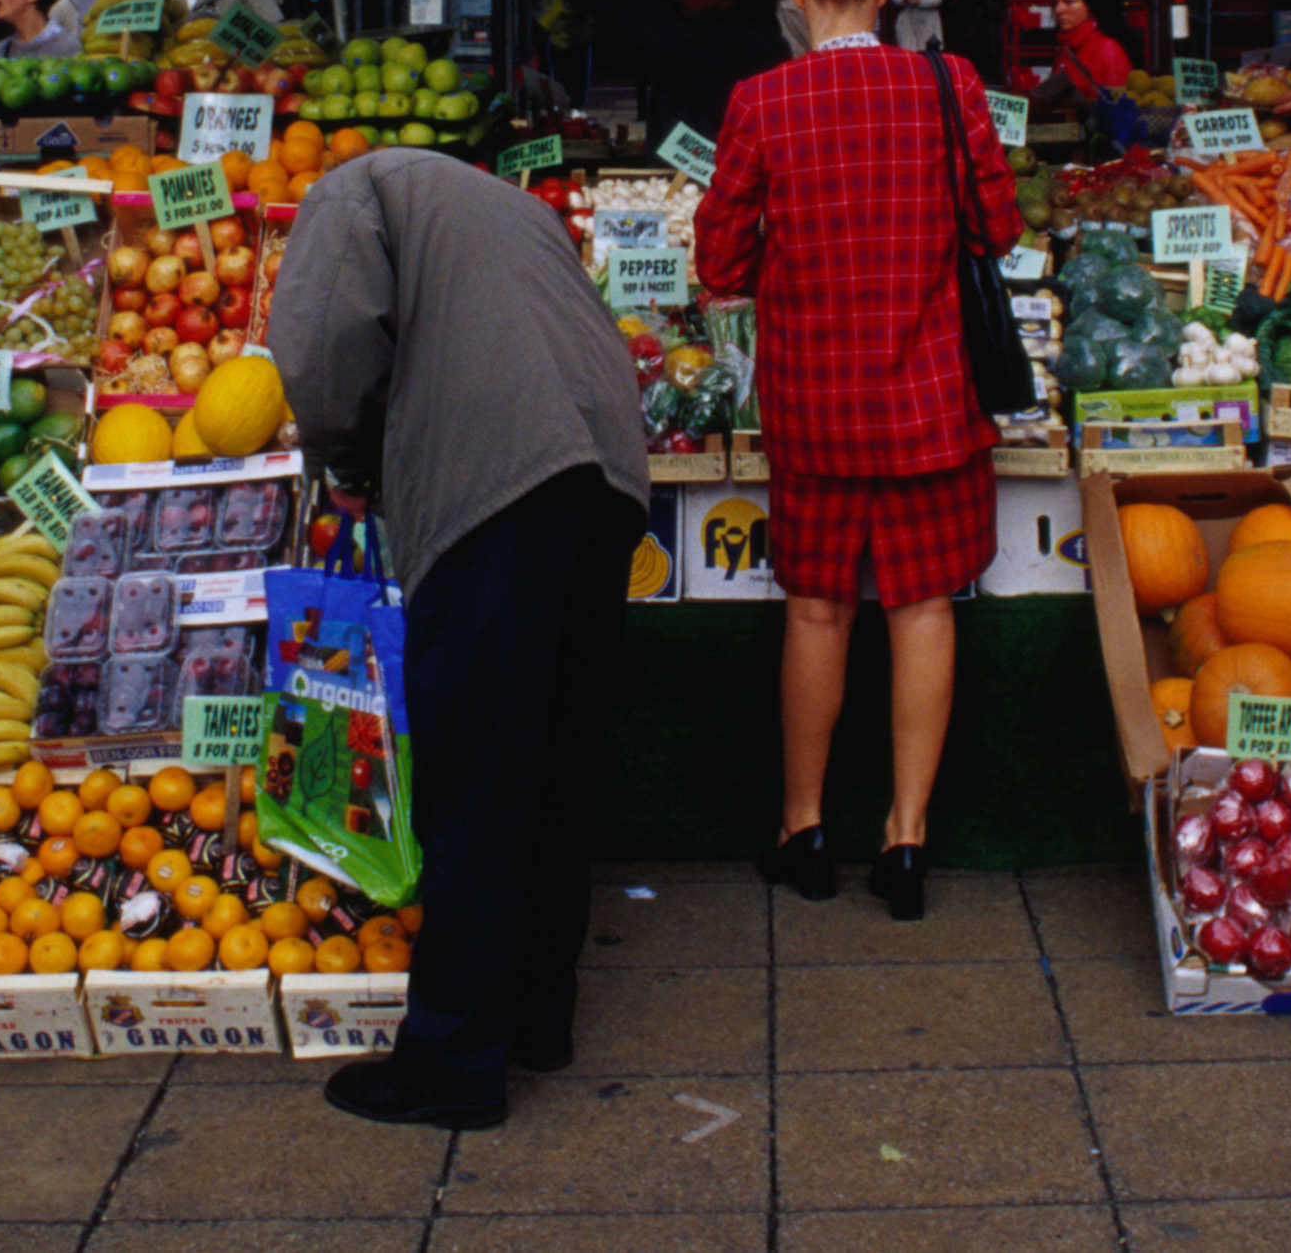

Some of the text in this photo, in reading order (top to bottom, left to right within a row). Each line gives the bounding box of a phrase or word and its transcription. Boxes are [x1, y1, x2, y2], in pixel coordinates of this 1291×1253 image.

[986, 96, 1026, 114] ERENCE
[194, 106, 261, 131] ORANGES
[1194, 115, 1250, 134] CARROTS
[191, 140, 201, 154] 5
[160, 168, 216, 206] POMMIES
[174, 206, 194, 220] FOR
[1166, 213, 1217, 240] SPROUTS
[1173, 242, 1198, 254] BAGS
[619, 258, 678, 277] PEPPERS
[33, 467, 89, 523] BANANA
[290, 669, 388, 716] Organic
[203, 703, 261, 738] TANGIES
[1239, 701, 1278, 735] TOFFEE
[91, 745, 157, 763] BEN-DOR
[205, 742, 229, 758] FOR
[1250, 739, 1275, 753] FOR
[157, 1017, 208, 1026] FRUTAS
[125, 1025, 266, 1048] GRAGON
[321, 1028, 395, 1047] GRA
